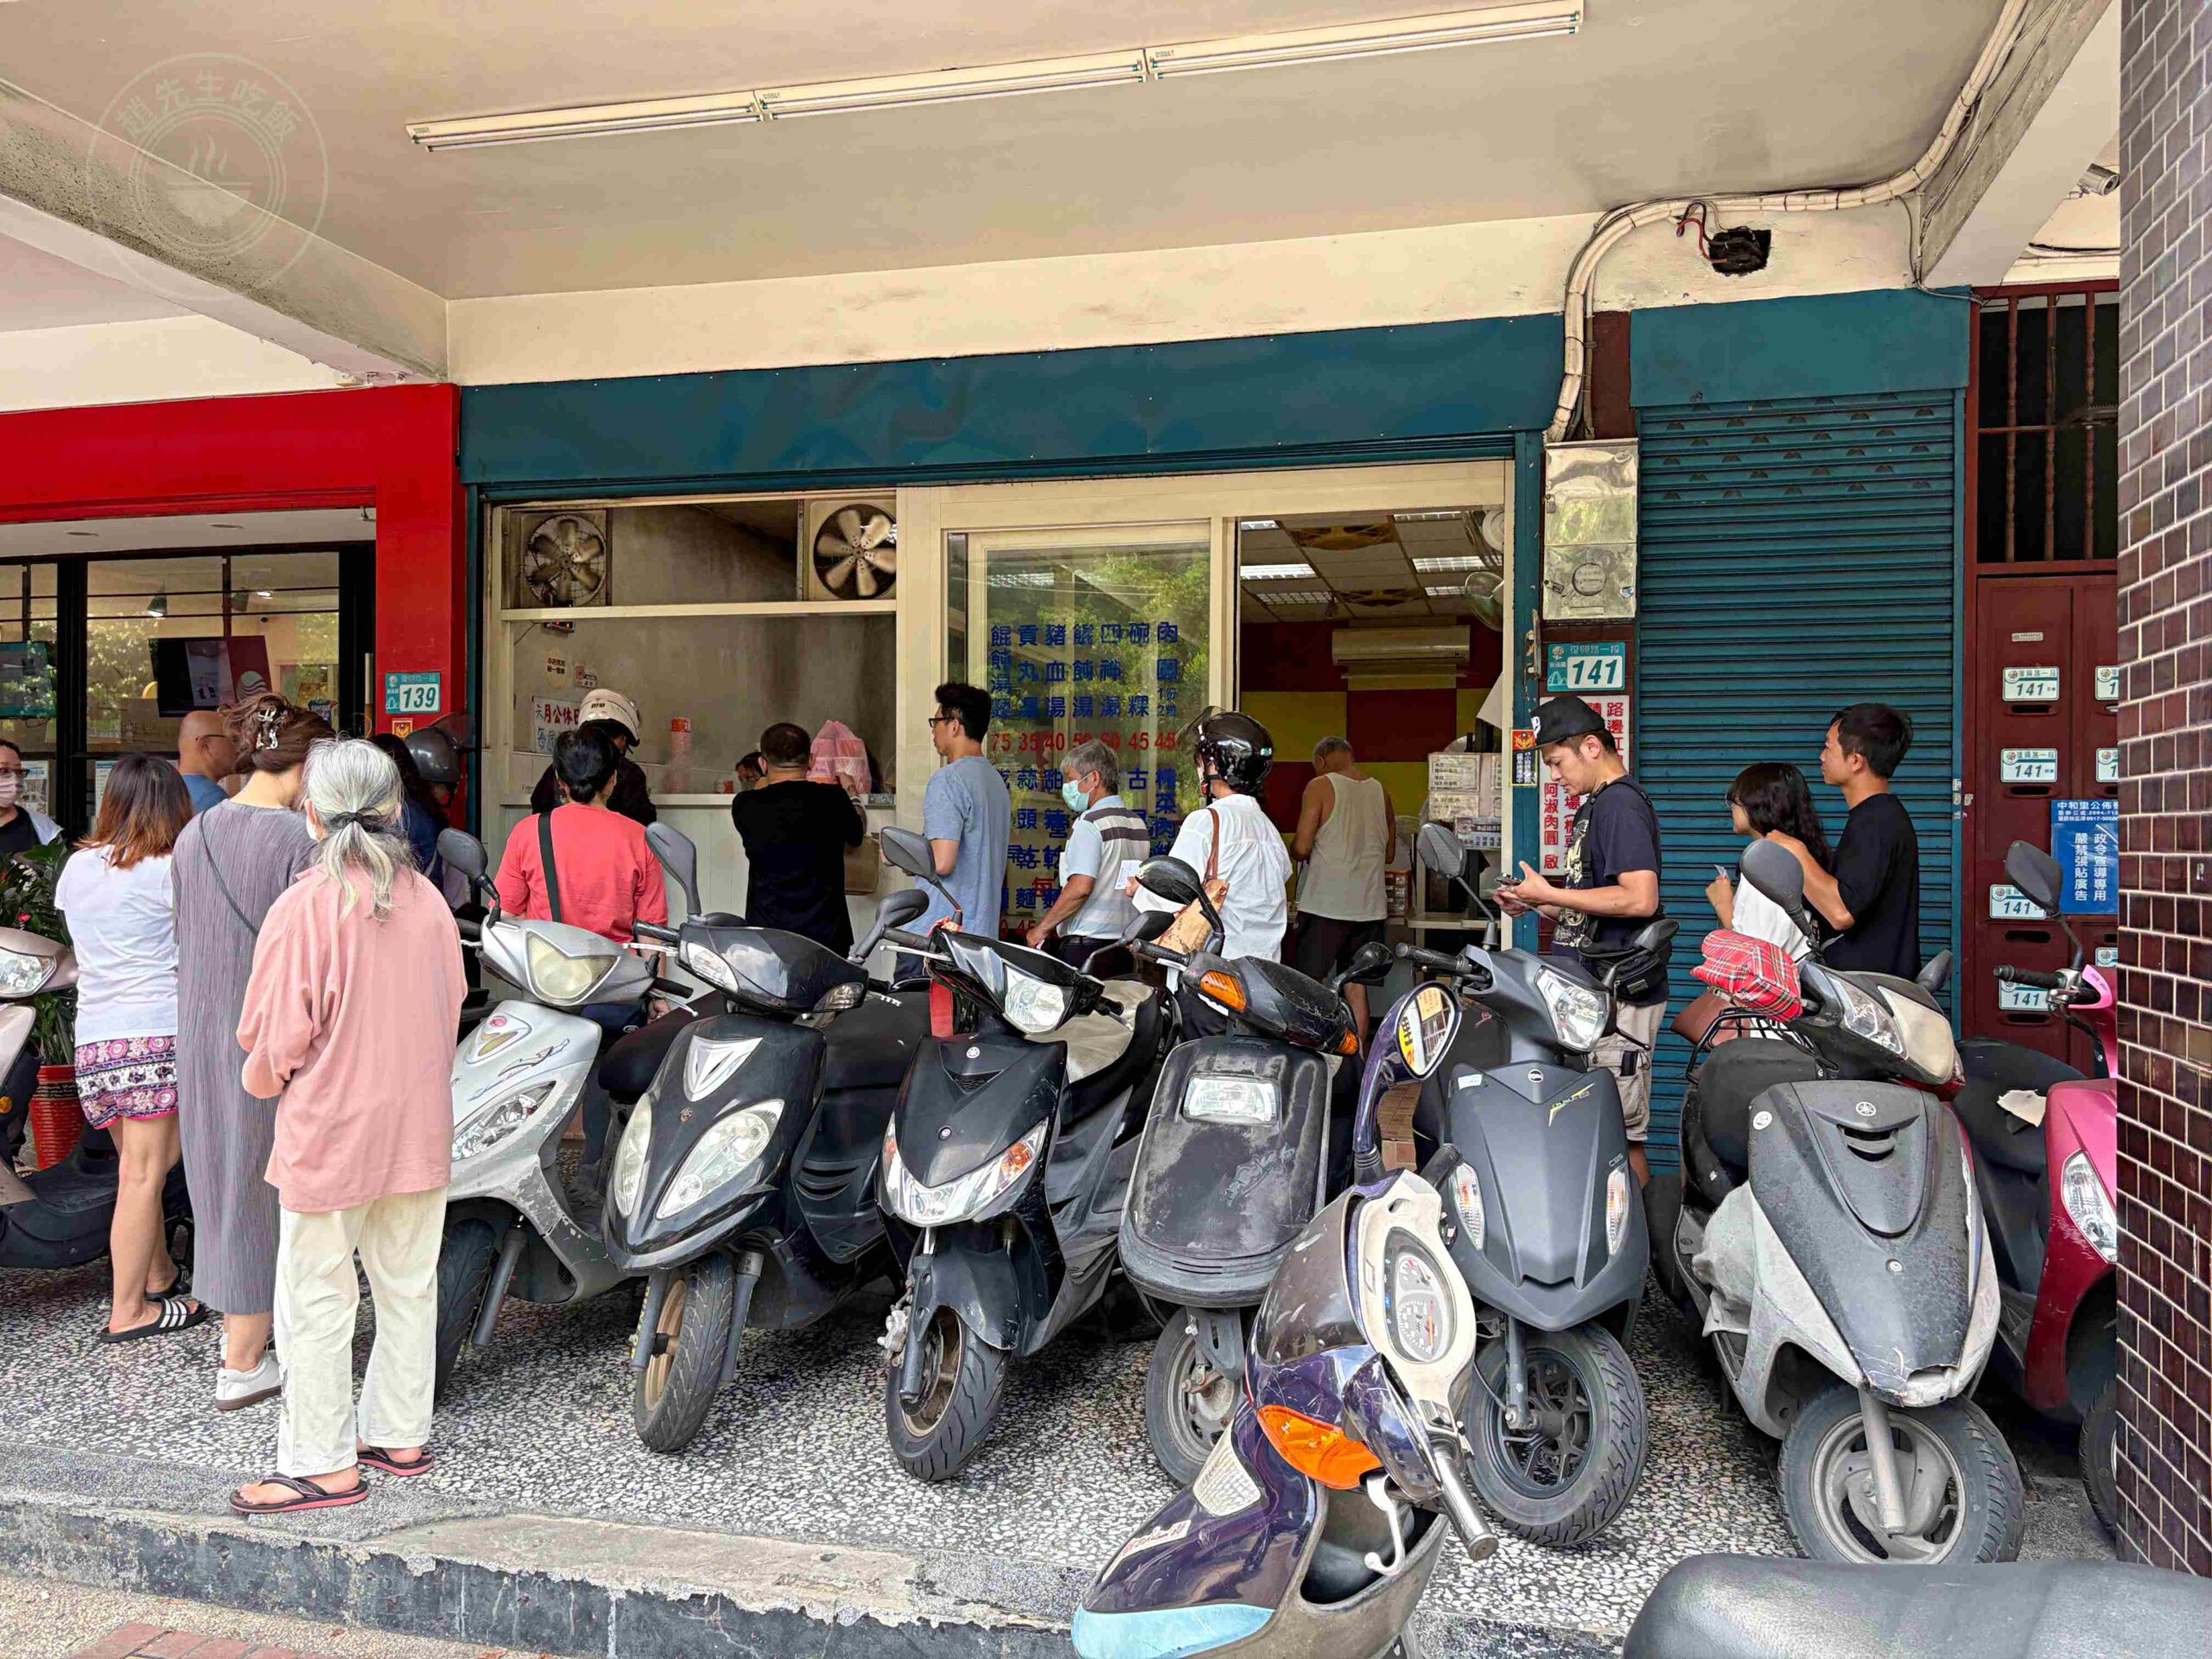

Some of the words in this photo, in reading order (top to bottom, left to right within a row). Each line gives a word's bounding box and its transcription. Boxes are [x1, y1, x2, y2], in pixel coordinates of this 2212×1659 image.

[1572, 659, 1618, 684] 141
[404, 687, 436, 709] 139
[2017, 683, 2044, 696] 141
[991, 733, 1011, 751] 75
[1018, 733, 1039, 751] 35
[1044, 733, 1065, 751] 40
[1128, 733, 1150, 751] 45
[2015, 765, 2042, 778] 141
[2075, 832, 2088, 901] 嚴禁張貼廣告
[2094, 832, 2107, 902] 政令宣導專用
[2004, 901, 2031, 914] 141
[2012, 993, 2039, 1006] 141
